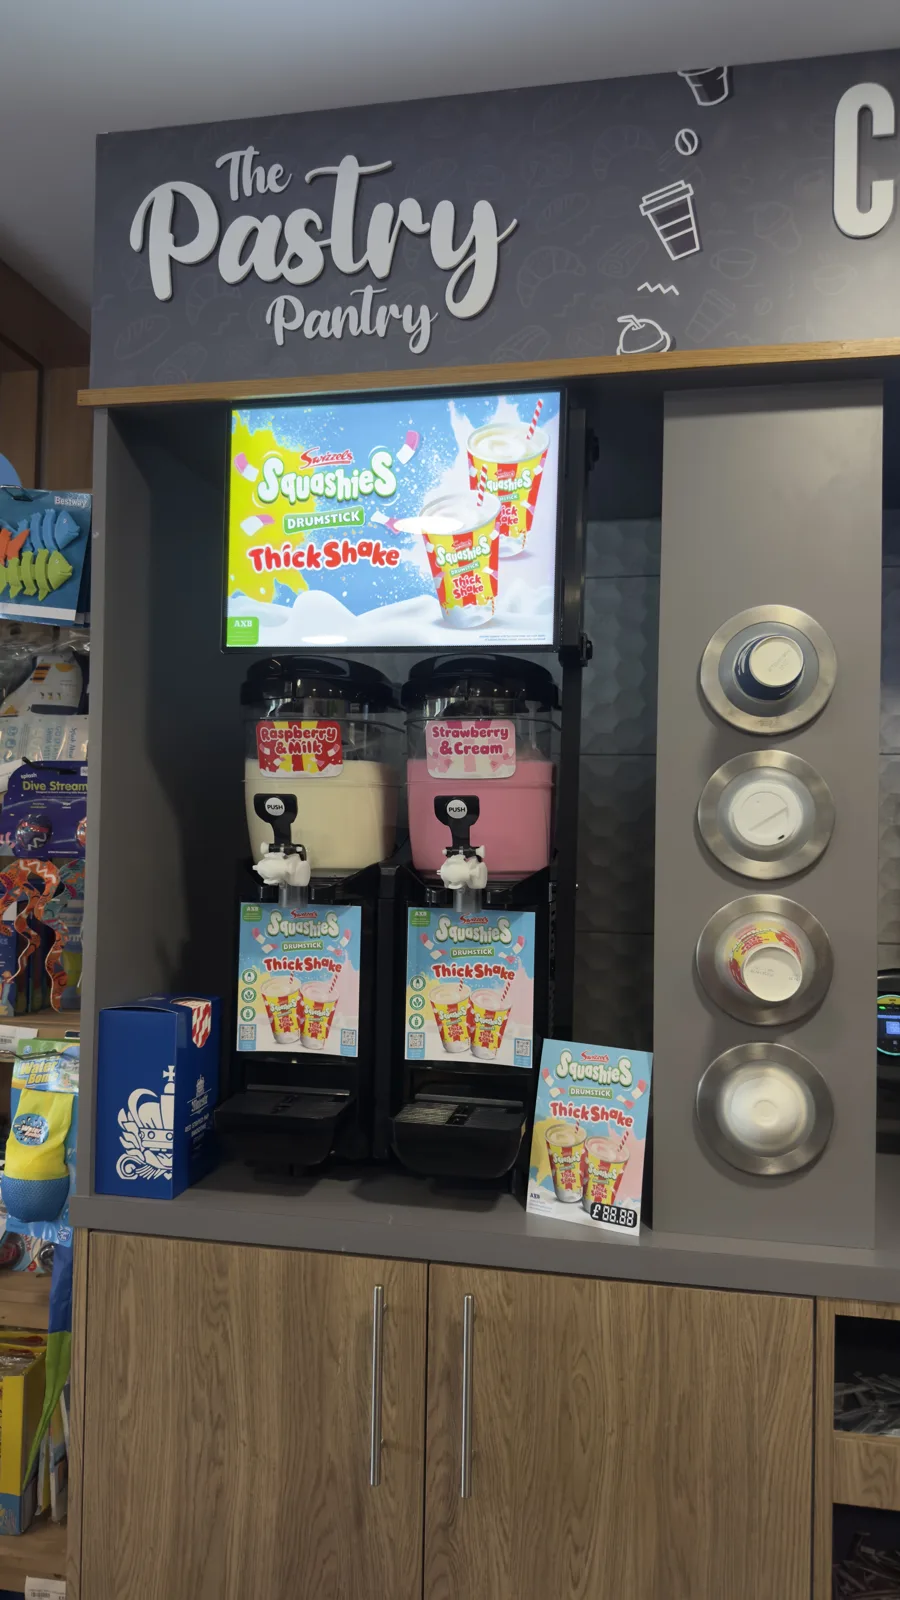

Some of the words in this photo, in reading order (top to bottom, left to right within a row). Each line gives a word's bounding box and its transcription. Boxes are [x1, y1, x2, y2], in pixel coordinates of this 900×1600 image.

[216, 146, 291, 201] The
[128, 155, 518, 318] Pastry
[265, 285, 437, 354] Pantry
[54, 496, 87, 507] Bestway
[287, 511, 361, 529] DRUMSTICK
[453, 574, 481, 588] Thick
[453, 585, 483, 599] Shake
[260, 725, 337, 742] Raspberry
[432, 726, 509, 740] Strawberry
[275, 741, 287, 754] &
[288, 740, 322, 755] Milk
[440, 740, 453, 755] &
[454, 742, 503, 755] Cream
[22, 781, 46, 791] Dive
[283, 942, 322, 950] DRUMSTICK
[20, 1061, 58, 1075] Water
[570, 1088, 611, 1097] DRUMSTICK
